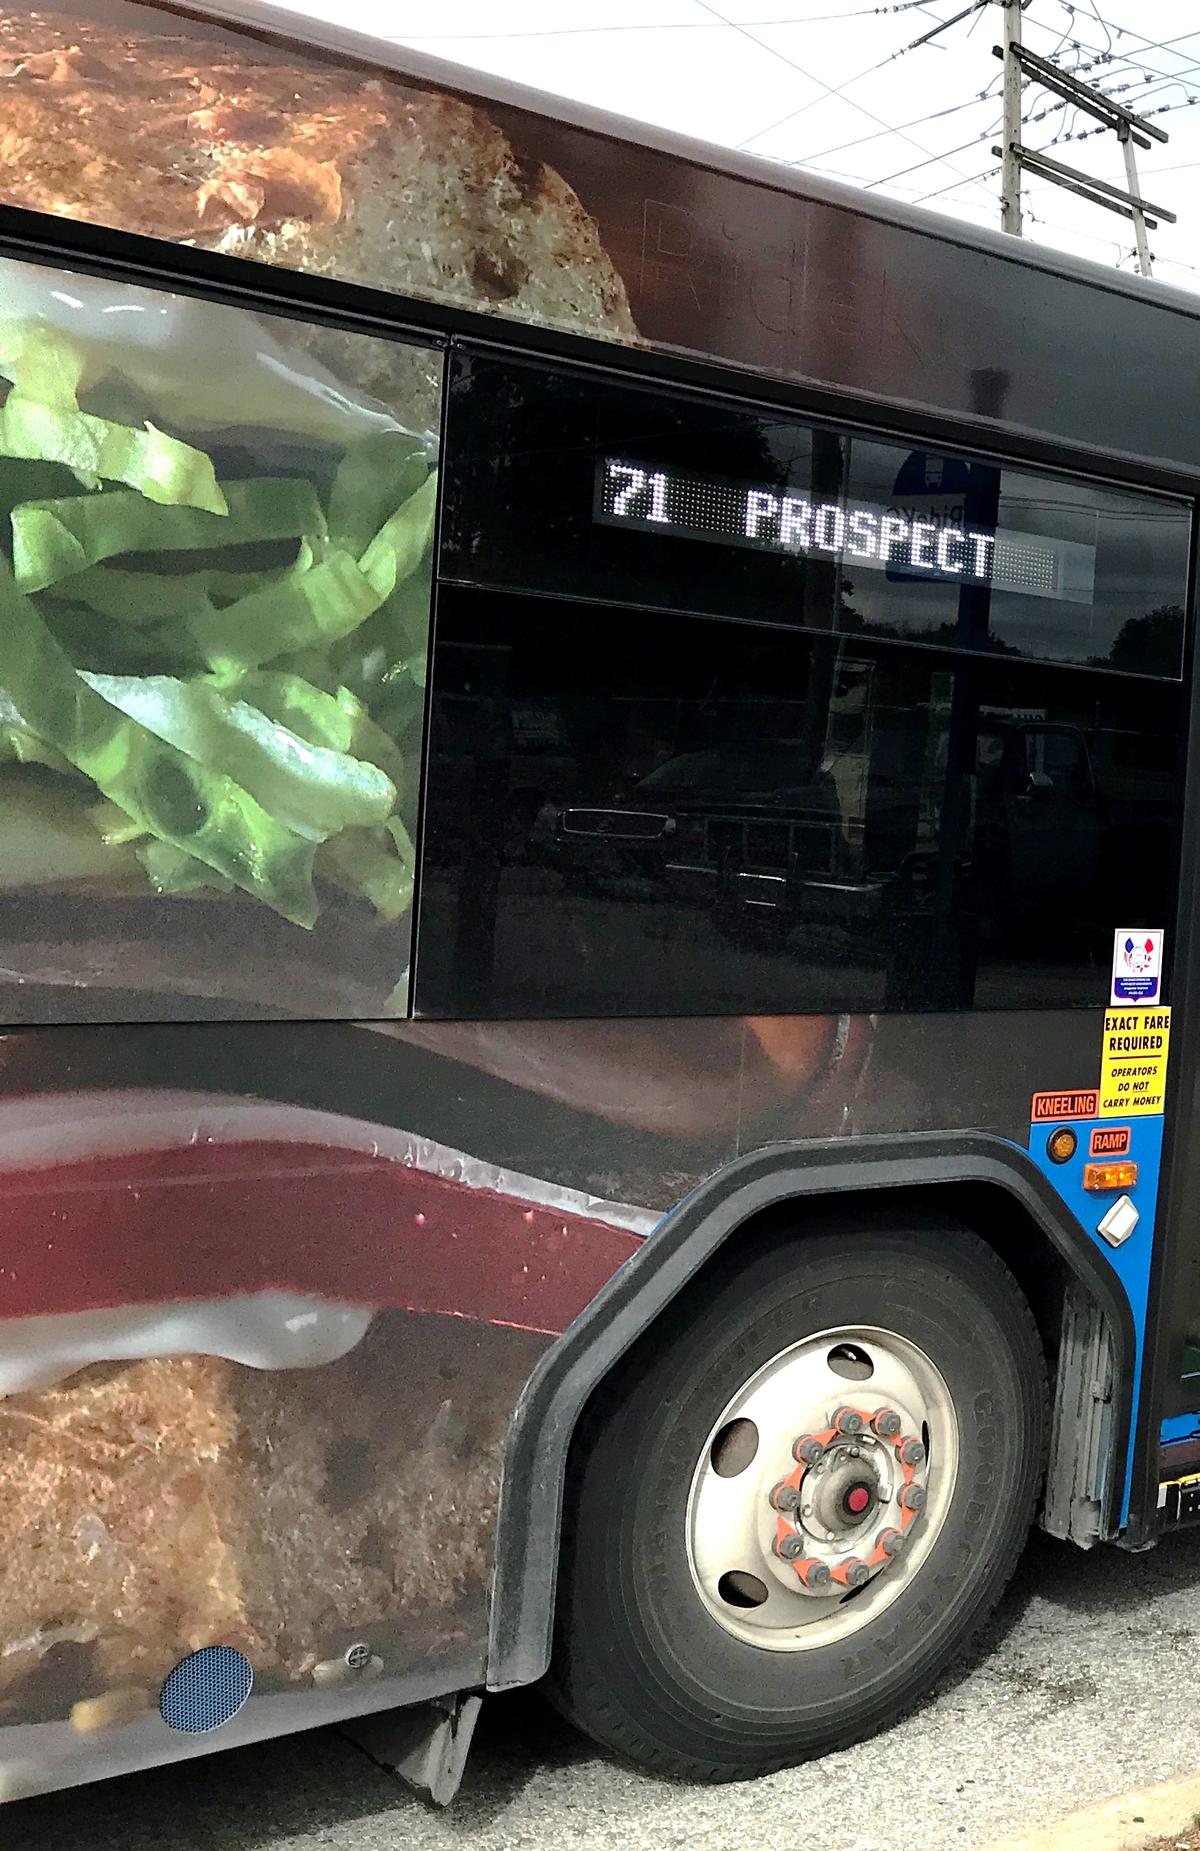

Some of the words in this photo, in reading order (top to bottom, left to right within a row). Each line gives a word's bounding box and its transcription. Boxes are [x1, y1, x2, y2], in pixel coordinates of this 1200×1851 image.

[609, 463, 670, 523] 71
[745, 489, 995, 578] PROSPECT
[1104, 1016, 1139, 1031] EXACT
[1143, 1015, 1170, 1030] FARE
[1109, 1035, 1163, 1052] REQUIRED
[1111, 1066, 1158, 1078] OPERATORS
[1117, 1082, 1130, 1092] DO
[1132, 1081, 1150, 1091] NOT
[1037, 1095, 1095, 1116] KNEELING
[1102, 1097, 1130, 1108] CARRY
[1132, 1095, 1162, 1106] MONEY
[1094, 1133, 1127, 1150] RAMP
